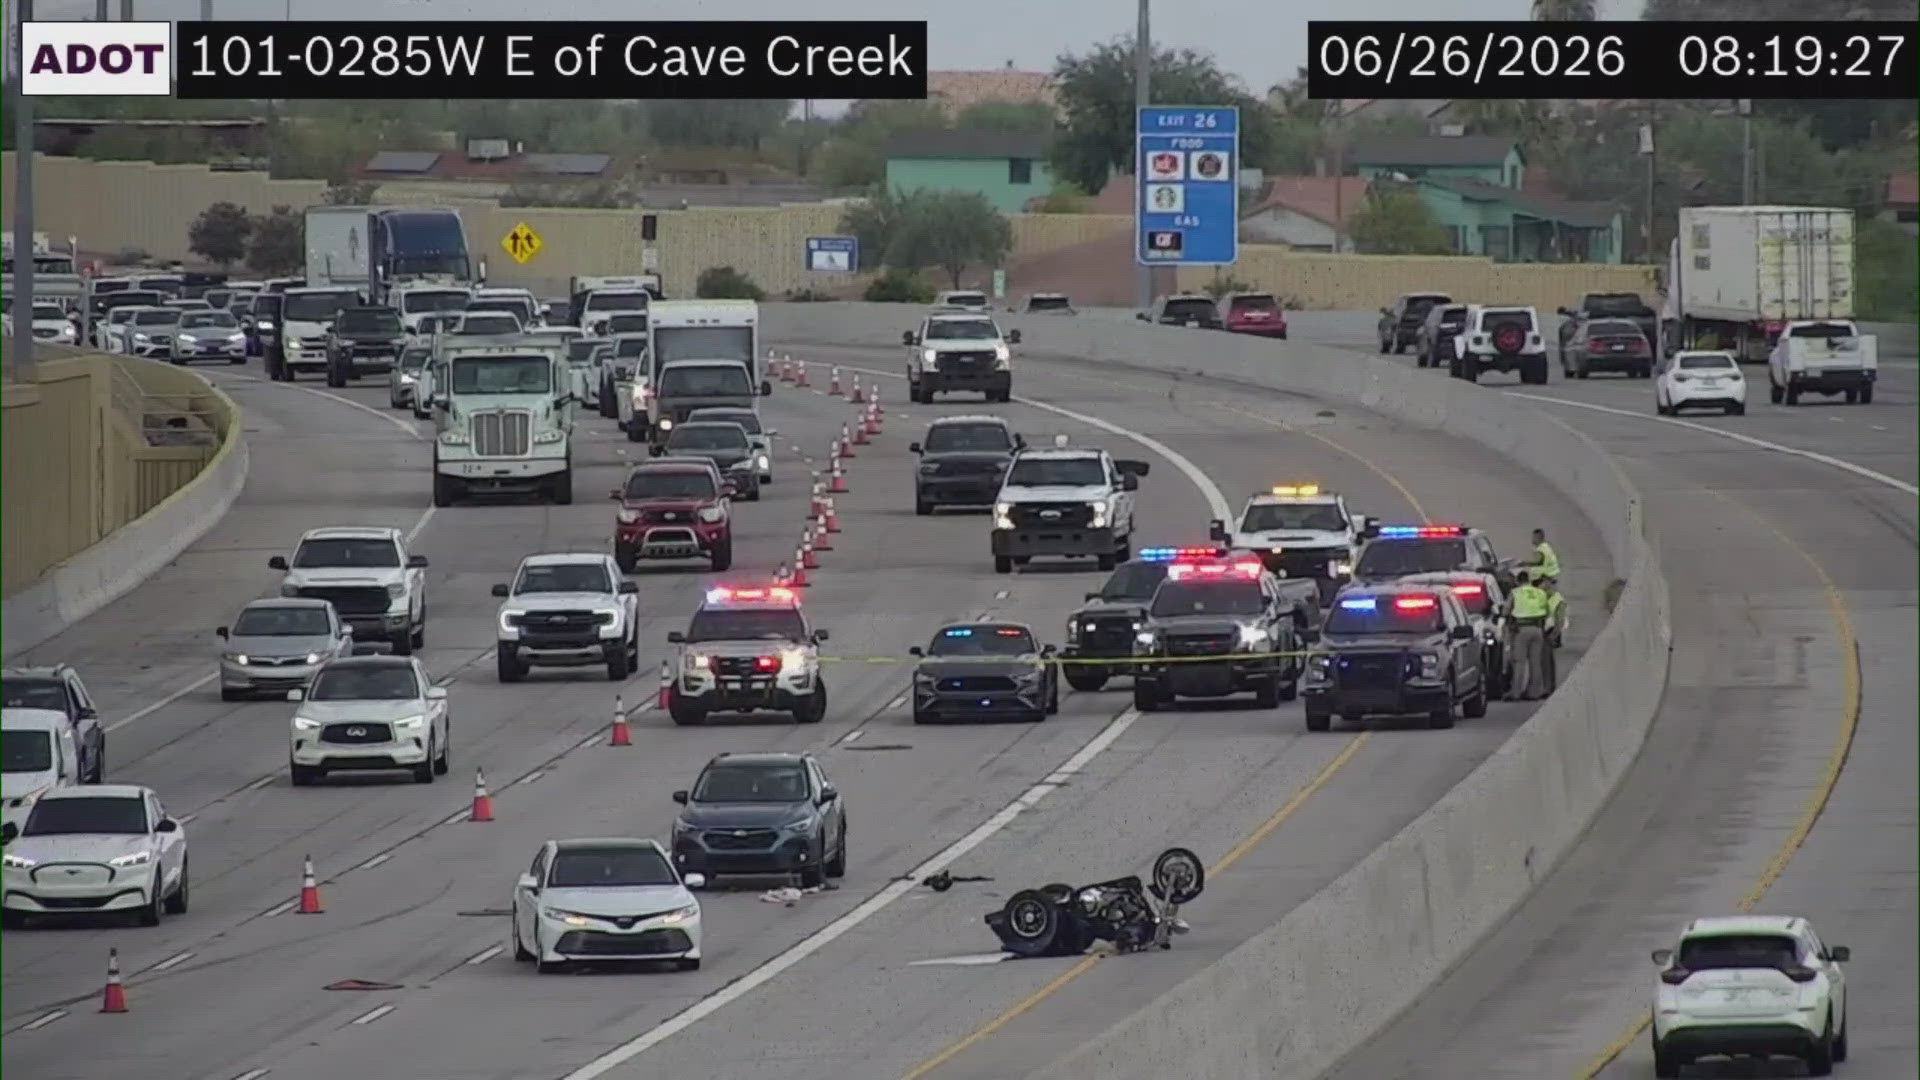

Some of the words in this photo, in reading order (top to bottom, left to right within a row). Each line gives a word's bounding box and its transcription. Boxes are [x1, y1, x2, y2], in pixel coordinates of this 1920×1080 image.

[1158, 115, 1185, 126] EXIT
[1195, 113, 1216, 128] 26
[1171, 138, 1203, 149] FOOD
[1174, 215, 1200, 227] GAS
